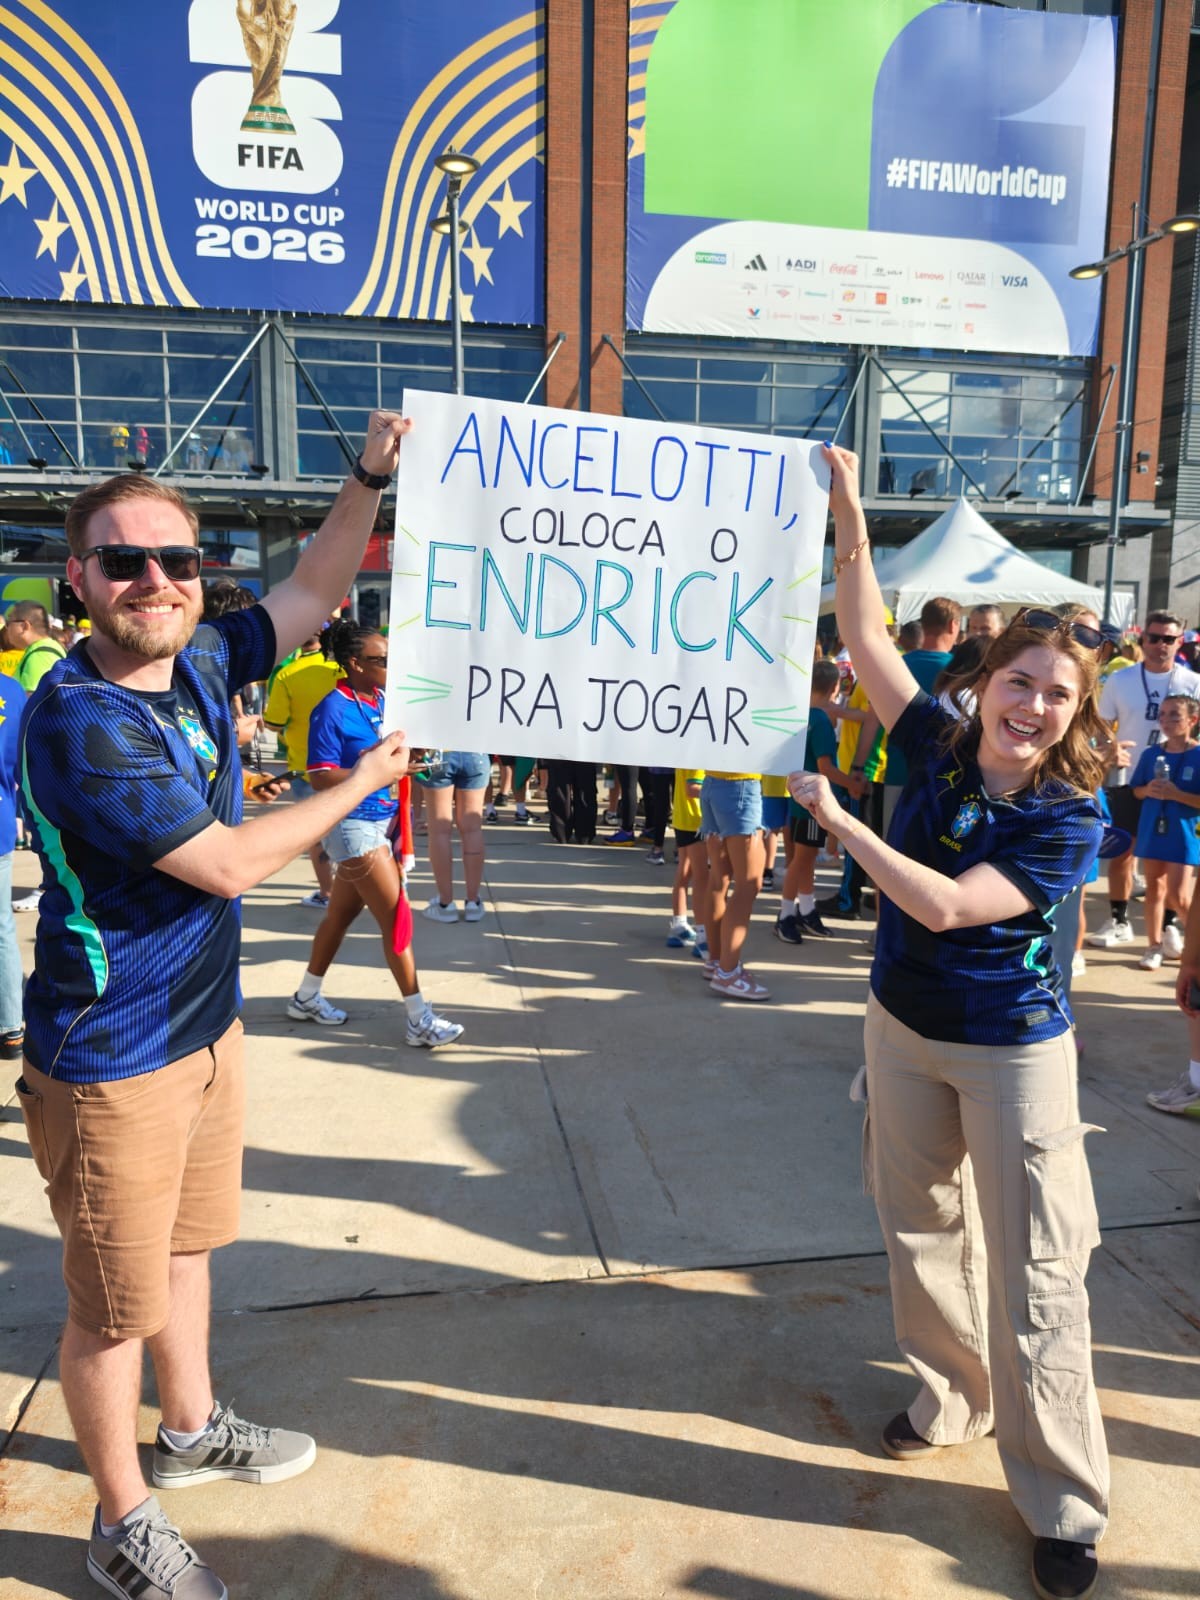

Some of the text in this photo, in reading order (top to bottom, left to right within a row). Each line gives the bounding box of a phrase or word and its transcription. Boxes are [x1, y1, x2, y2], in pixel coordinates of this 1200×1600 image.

[237, 143, 304, 171] FIFA
[886, 157, 1067, 206] #FIFAWorldCup
[194, 198, 345, 226] WORLD CUP
[195, 224, 346, 265] 2026
[794, 259, 816, 270] ADI
[1002, 275, 1029, 288] VISA
[441, 412, 798, 531] ANCELOTTI,
[500, 507, 739, 563] COLOCA O
[425, 541, 775, 665] ENDRICK
[466, 665, 750, 747] PRA JOGAR
